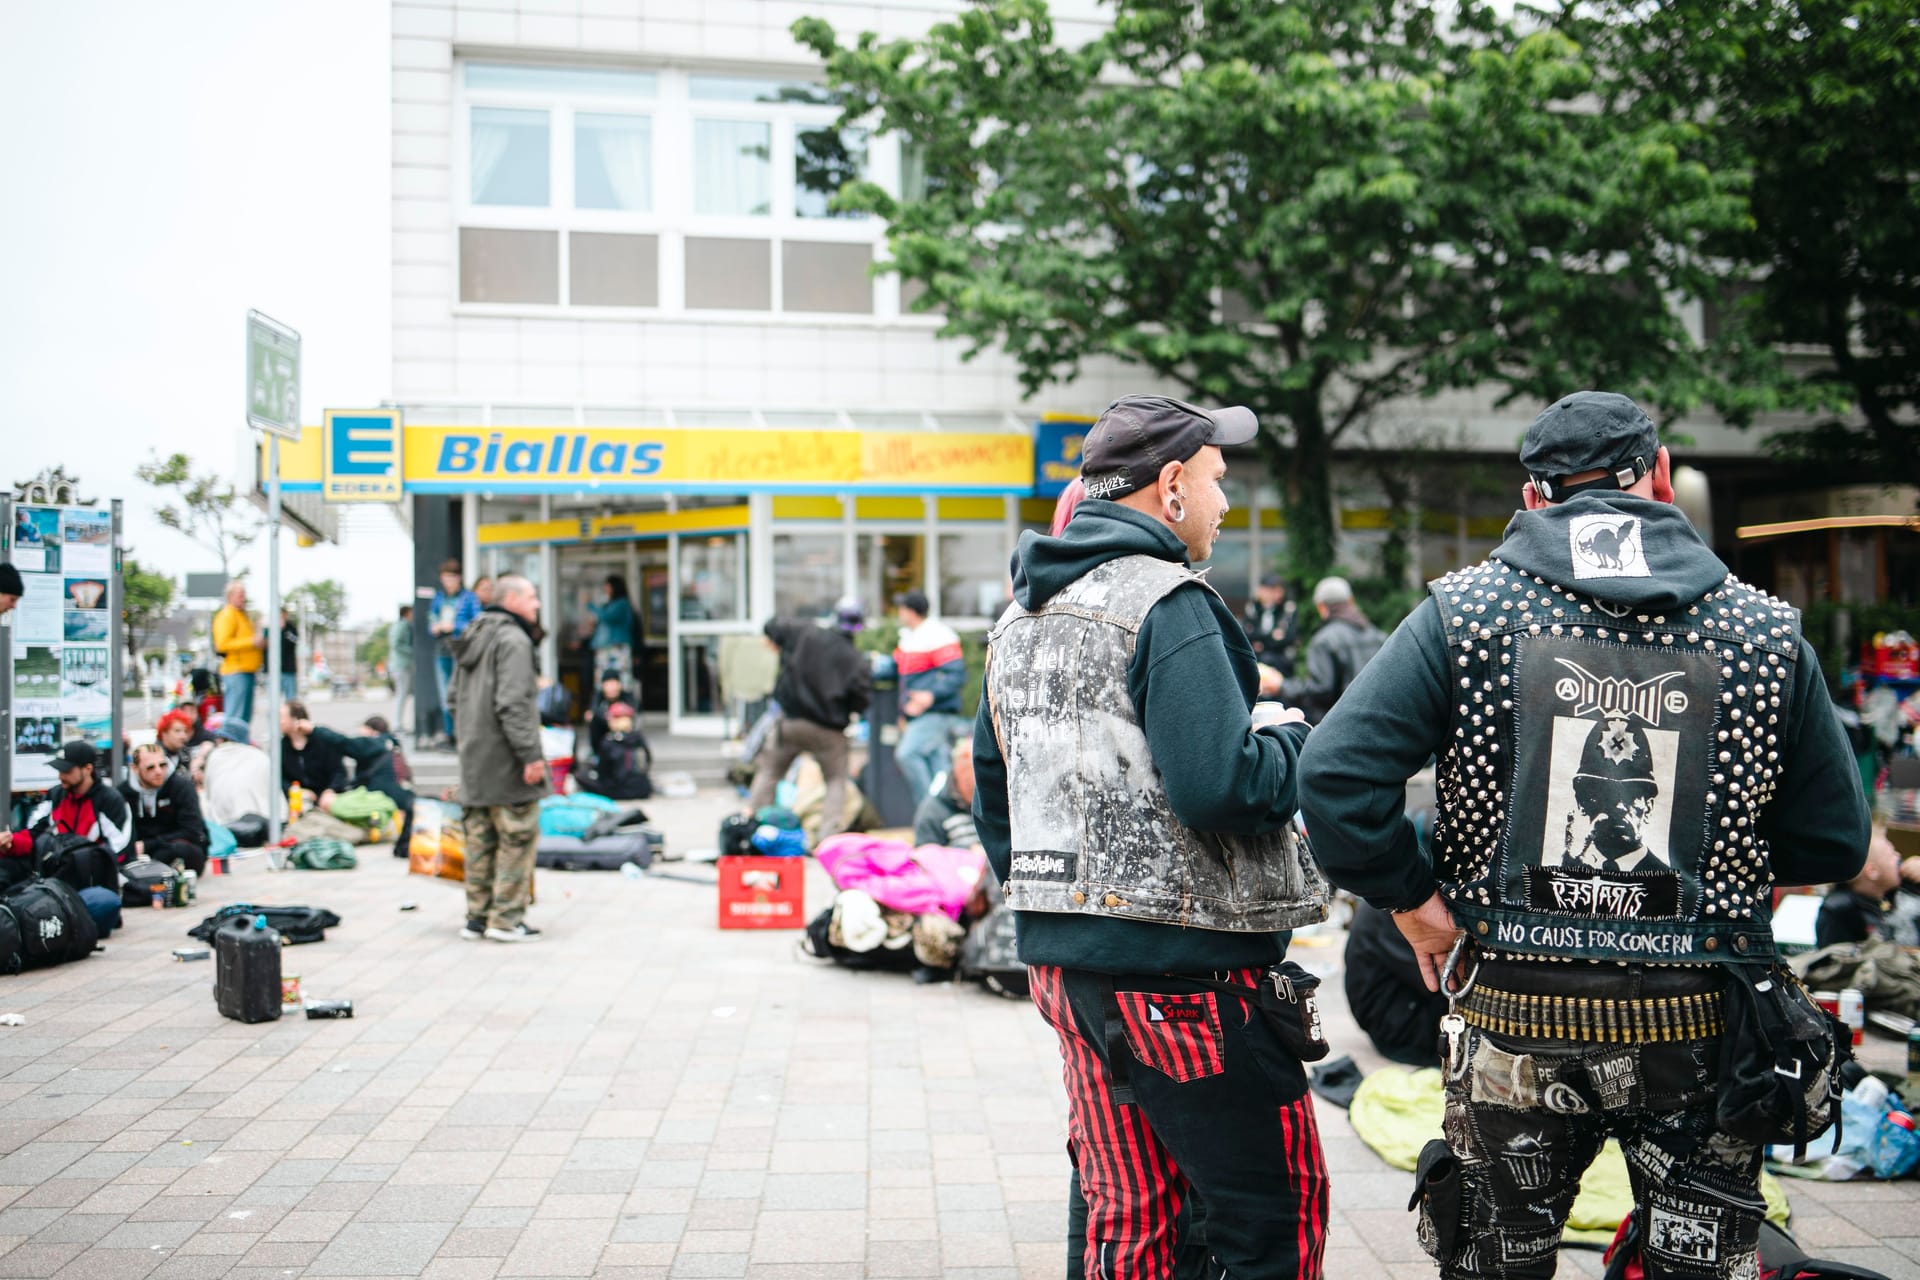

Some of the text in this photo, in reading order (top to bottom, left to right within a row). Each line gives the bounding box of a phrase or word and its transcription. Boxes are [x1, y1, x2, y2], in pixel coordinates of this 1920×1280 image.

[436, 433, 664, 475] Biallas
[331, 482, 395, 493] EDEKA
[1554, 657, 1685, 727] DOOM
[1549, 877, 1648, 917] RESTARTS
[1498, 921, 1693, 955] NO CAUSE FOR CONCERN
[1162, 1004, 1199, 1019] SHARK
[1602, 1055, 1634, 1081] MORD
[1619, 1074, 1638, 1090] DIE
[1649, 1189, 1725, 1217] CONFLICT
